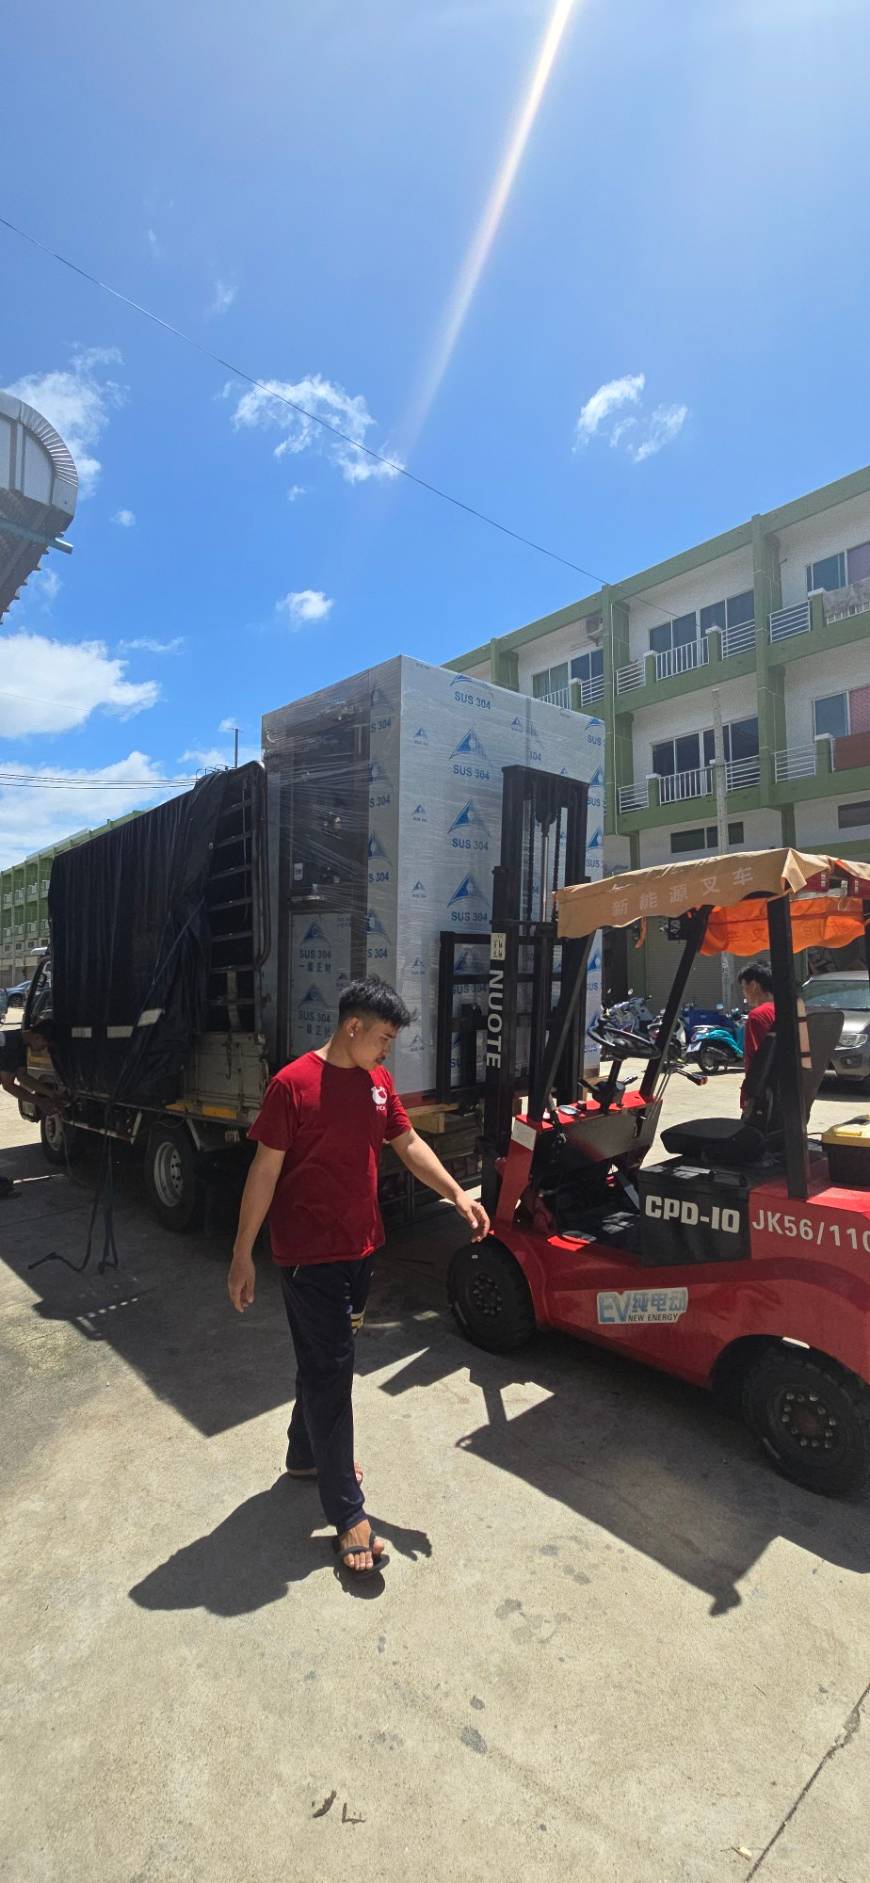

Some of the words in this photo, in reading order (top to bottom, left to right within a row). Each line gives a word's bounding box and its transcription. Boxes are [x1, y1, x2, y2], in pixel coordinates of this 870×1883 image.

[454, 691, 474, 705] SUS
[475, 697, 491, 710] 304
[453, 764, 473, 777] SUS
[452, 838, 471, 849] SUS
[473, 841, 489, 851] 304
[611, 865, 754, 918] 新能源叉车
[451, 912, 471, 922] SUS
[472, 912, 488, 922] 304
[486, 969, 505, 1069] NUOTE
[645, 1194, 740, 1234] CPD-10
[628, 1314, 645, 1322] NEW
[647, 1312, 678, 1321] ENERGY
